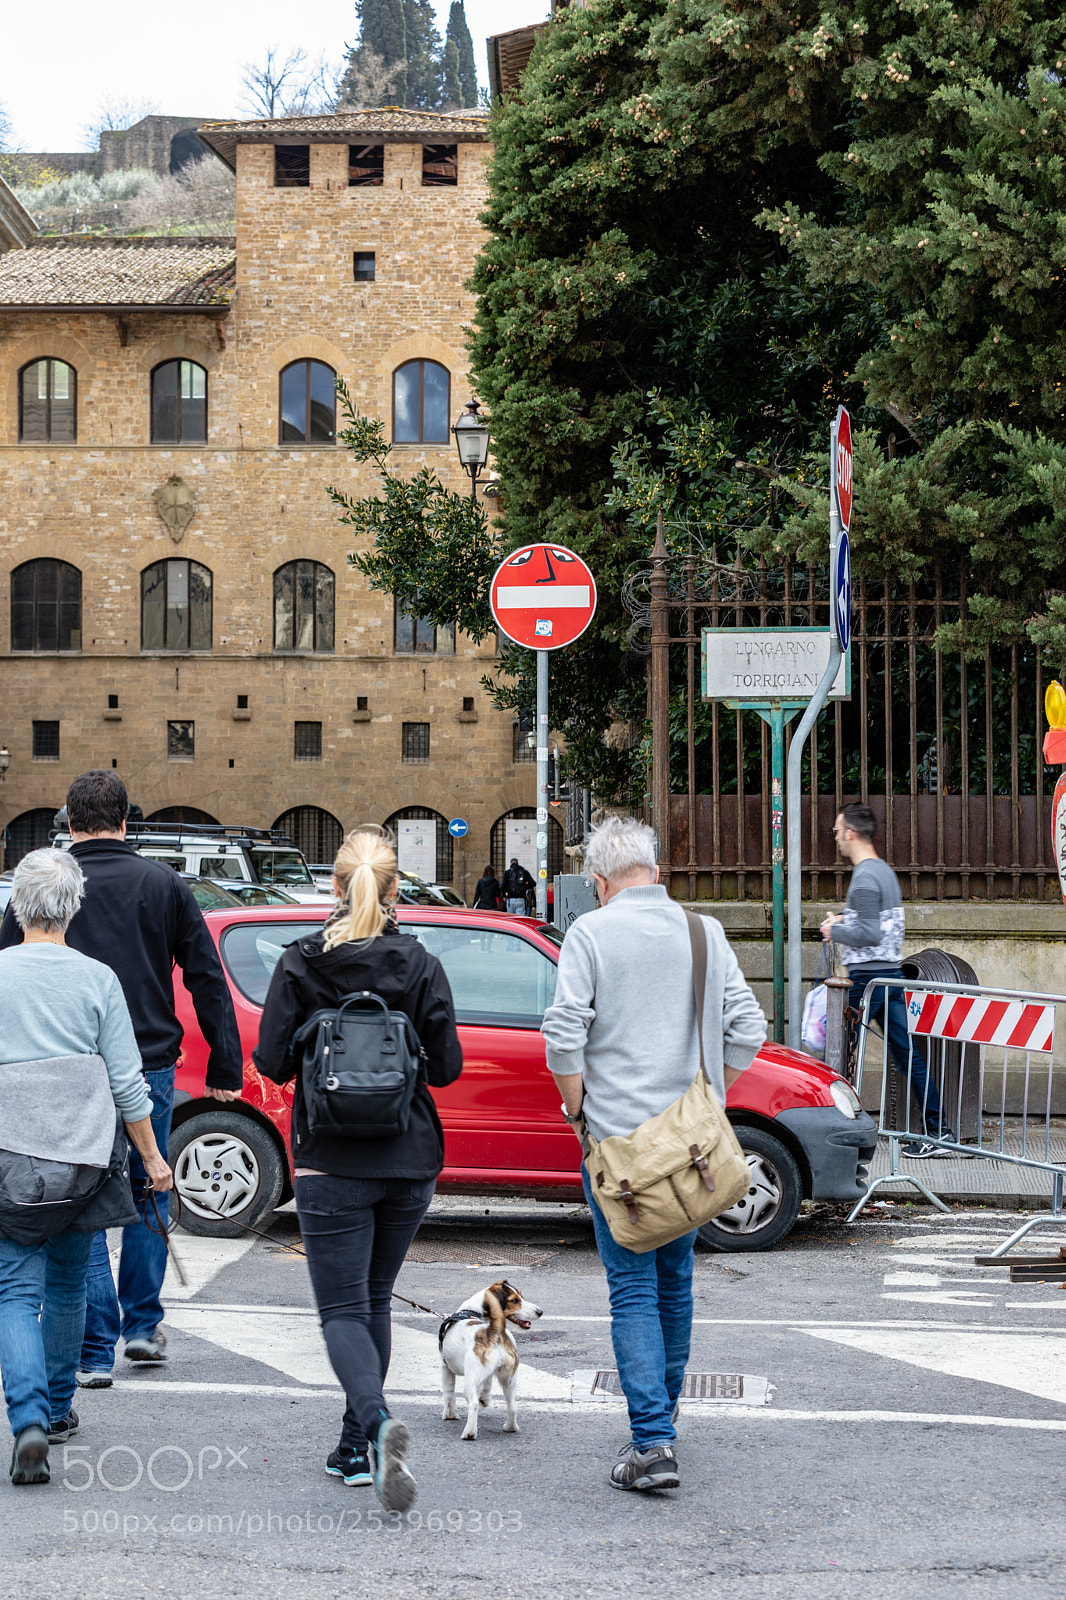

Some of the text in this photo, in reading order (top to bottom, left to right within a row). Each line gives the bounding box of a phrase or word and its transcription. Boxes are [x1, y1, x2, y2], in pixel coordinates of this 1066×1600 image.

[837, 442, 852, 495] STOP
[735, 641, 816, 656] LUNGARNO
[733, 673, 819, 688] TORRIGIANI
